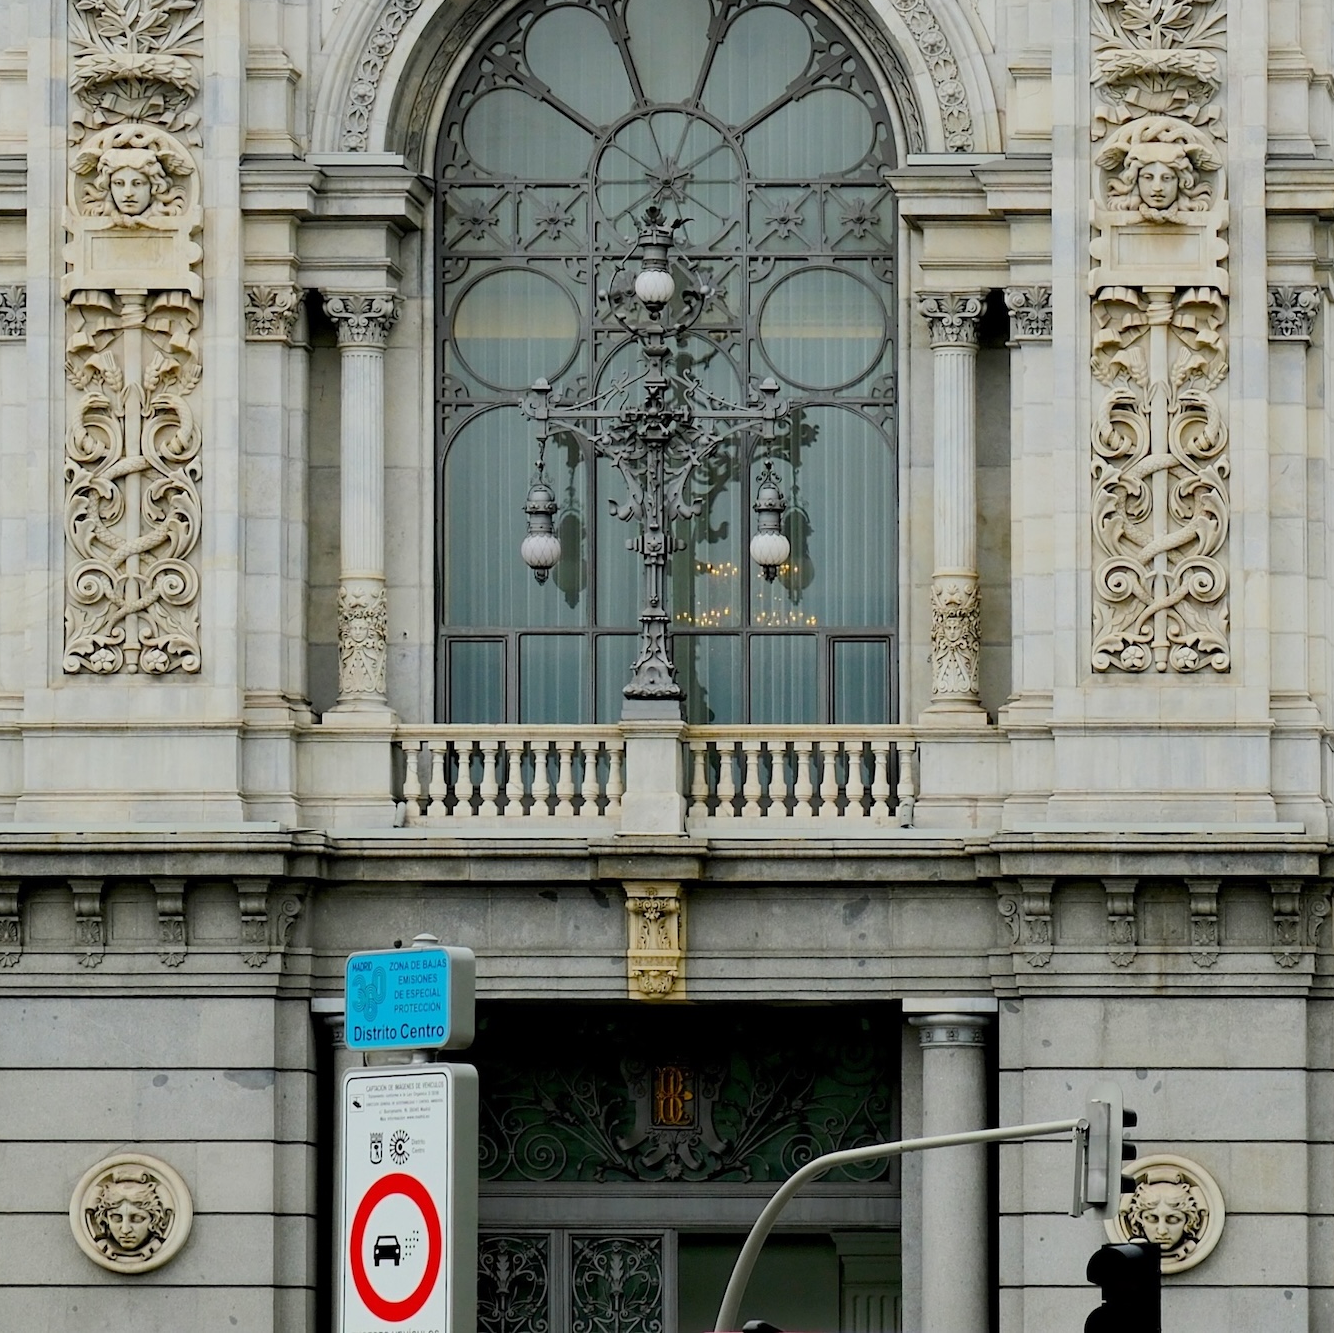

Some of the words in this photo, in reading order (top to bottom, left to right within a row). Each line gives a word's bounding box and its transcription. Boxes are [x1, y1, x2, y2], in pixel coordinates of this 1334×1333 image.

[352, 961, 372, 972] MADRID
[389, 961, 409, 972] ZONA
[410, 960, 421, 970] DE
[422, 958, 447, 969] BAJAS
[398, 973, 438, 985] EMISIONES
[394, 990, 404, 1000] DE
[405, 987, 441, 999] ESPECIAL
[354, 1024, 397, 1042] Distrito
[400, 1023, 445, 1039] Centro
